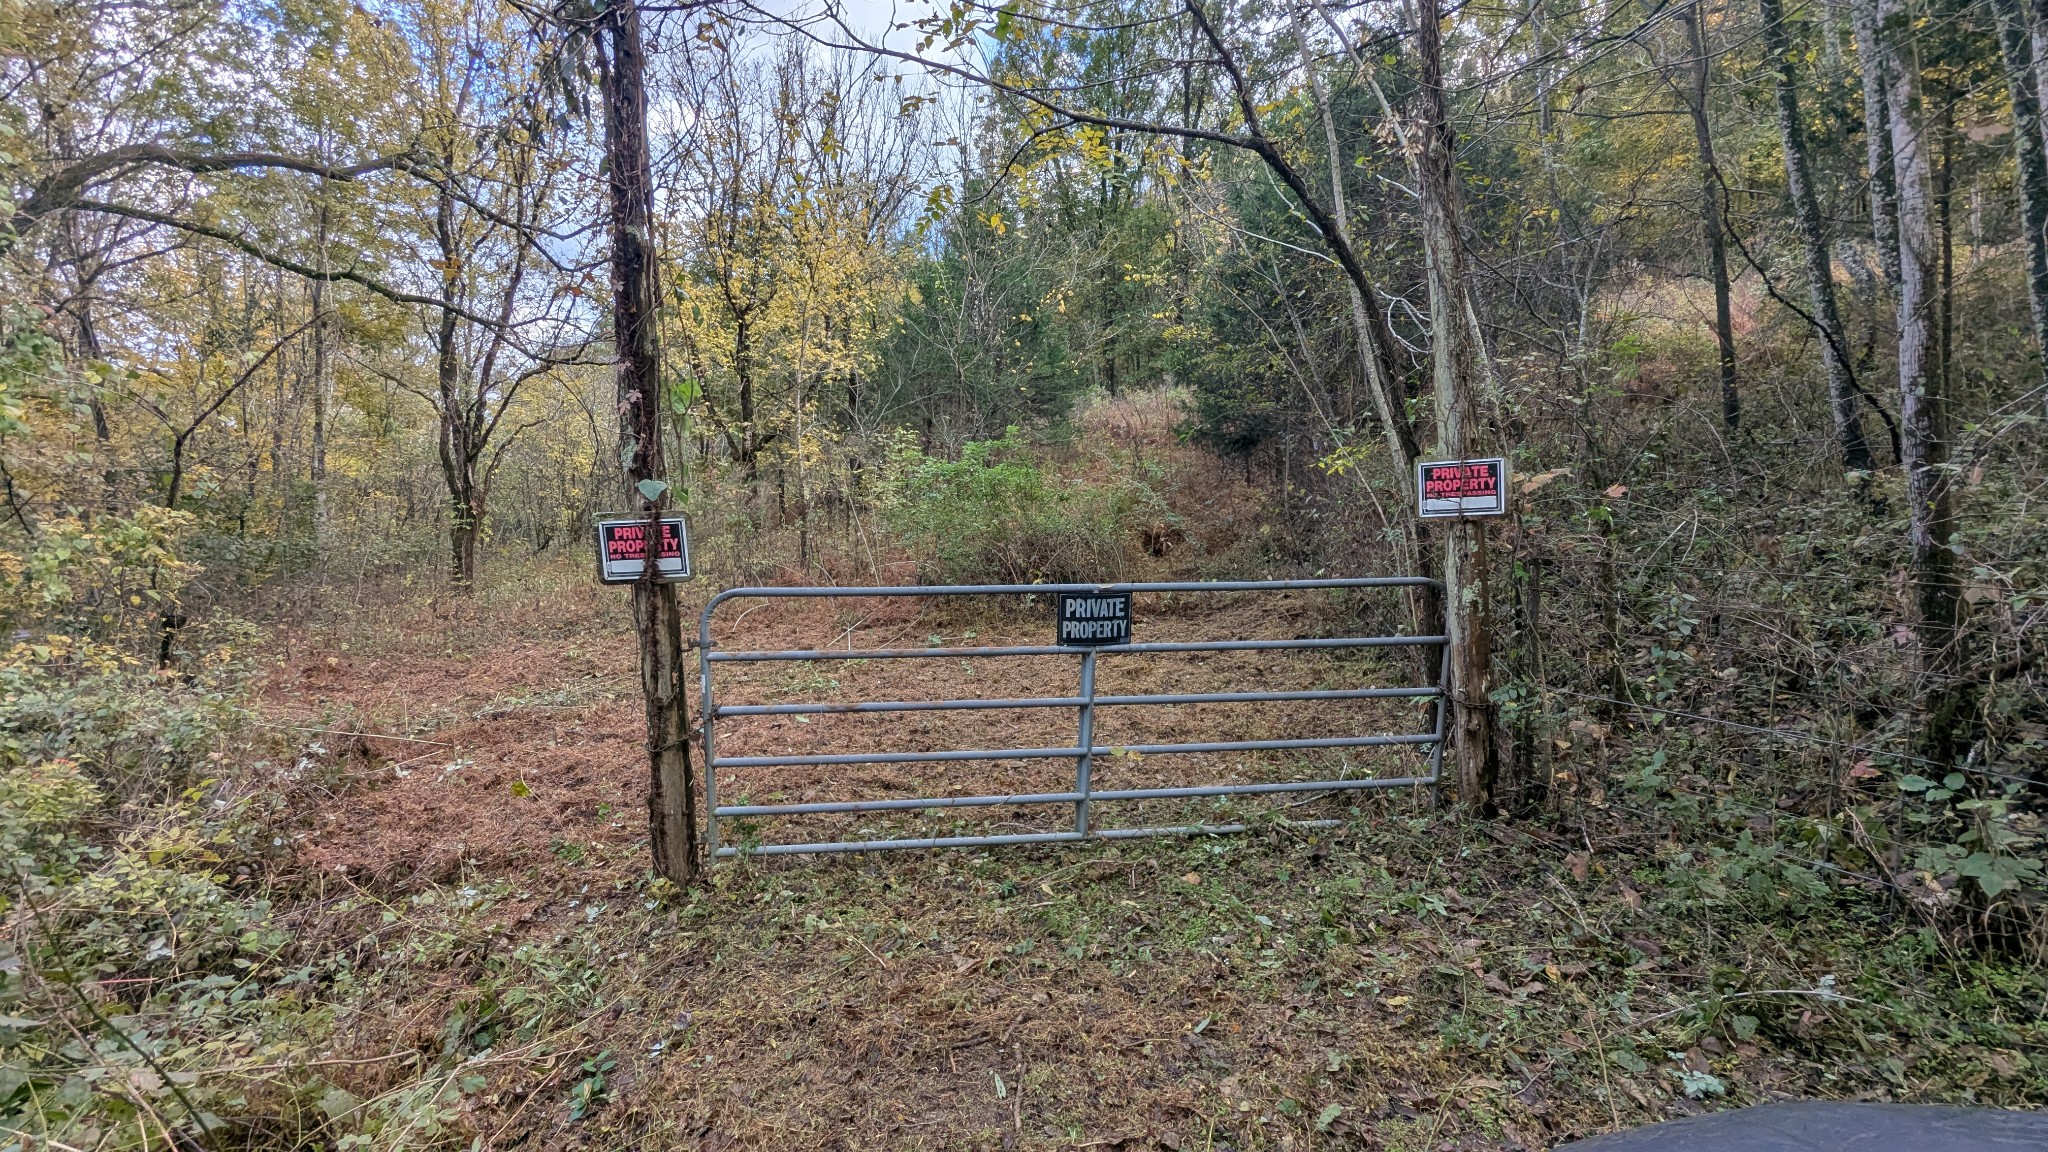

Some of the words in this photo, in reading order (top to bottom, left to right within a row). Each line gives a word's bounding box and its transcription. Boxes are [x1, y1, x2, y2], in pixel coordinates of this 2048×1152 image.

[1441, 489, 1496, 498] TRESASSING
[614, 525, 671, 540] PRIVE
[608, 538, 679, 553] PROPTY
[623, 551, 681, 559] TRESSING
[1065, 598, 1125, 617] PRIVATE
[1062, 619, 1127, 639] PROPERTY
